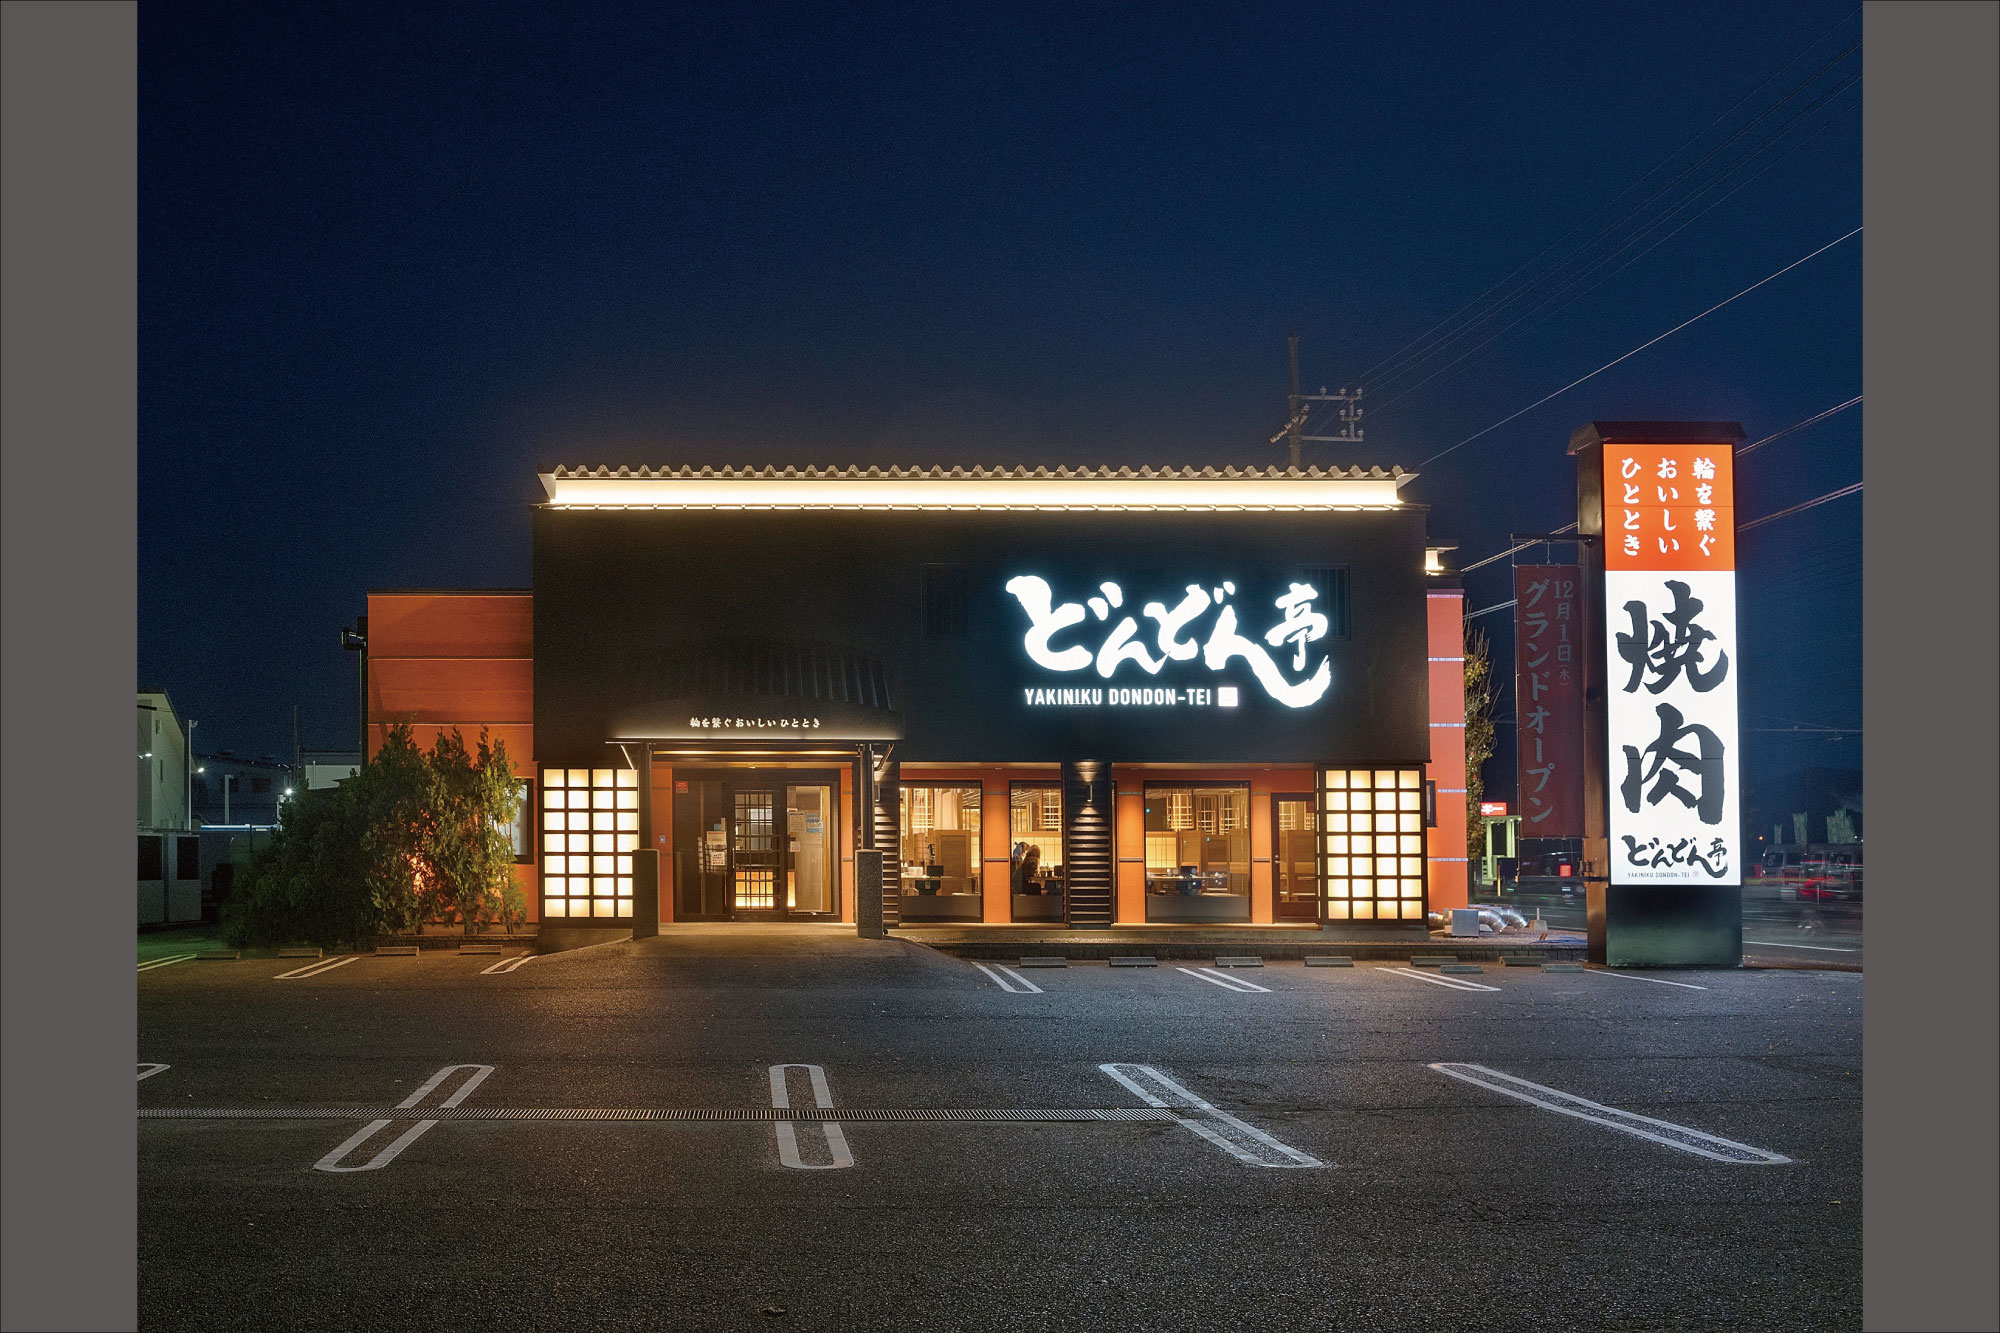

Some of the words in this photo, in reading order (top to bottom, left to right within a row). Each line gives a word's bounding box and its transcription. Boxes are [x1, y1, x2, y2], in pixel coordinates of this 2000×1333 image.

[1621, 457, 1642, 556] ひととき
[1657, 457, 1680, 554] おいしい
[1692, 457, 1717, 557] 輪を繋ぐ
[1005, 575, 1332, 708] どんどん亭
[1024, 688, 1103, 706] YAKINIKU
[1108, 688, 1211, 706] DONDON-TEI
[1524, 579, 1555, 823] グランドオープン
[1615, 579, 1729, 826] 焼肉
[1621, 834, 1729, 879] どんどん亭
